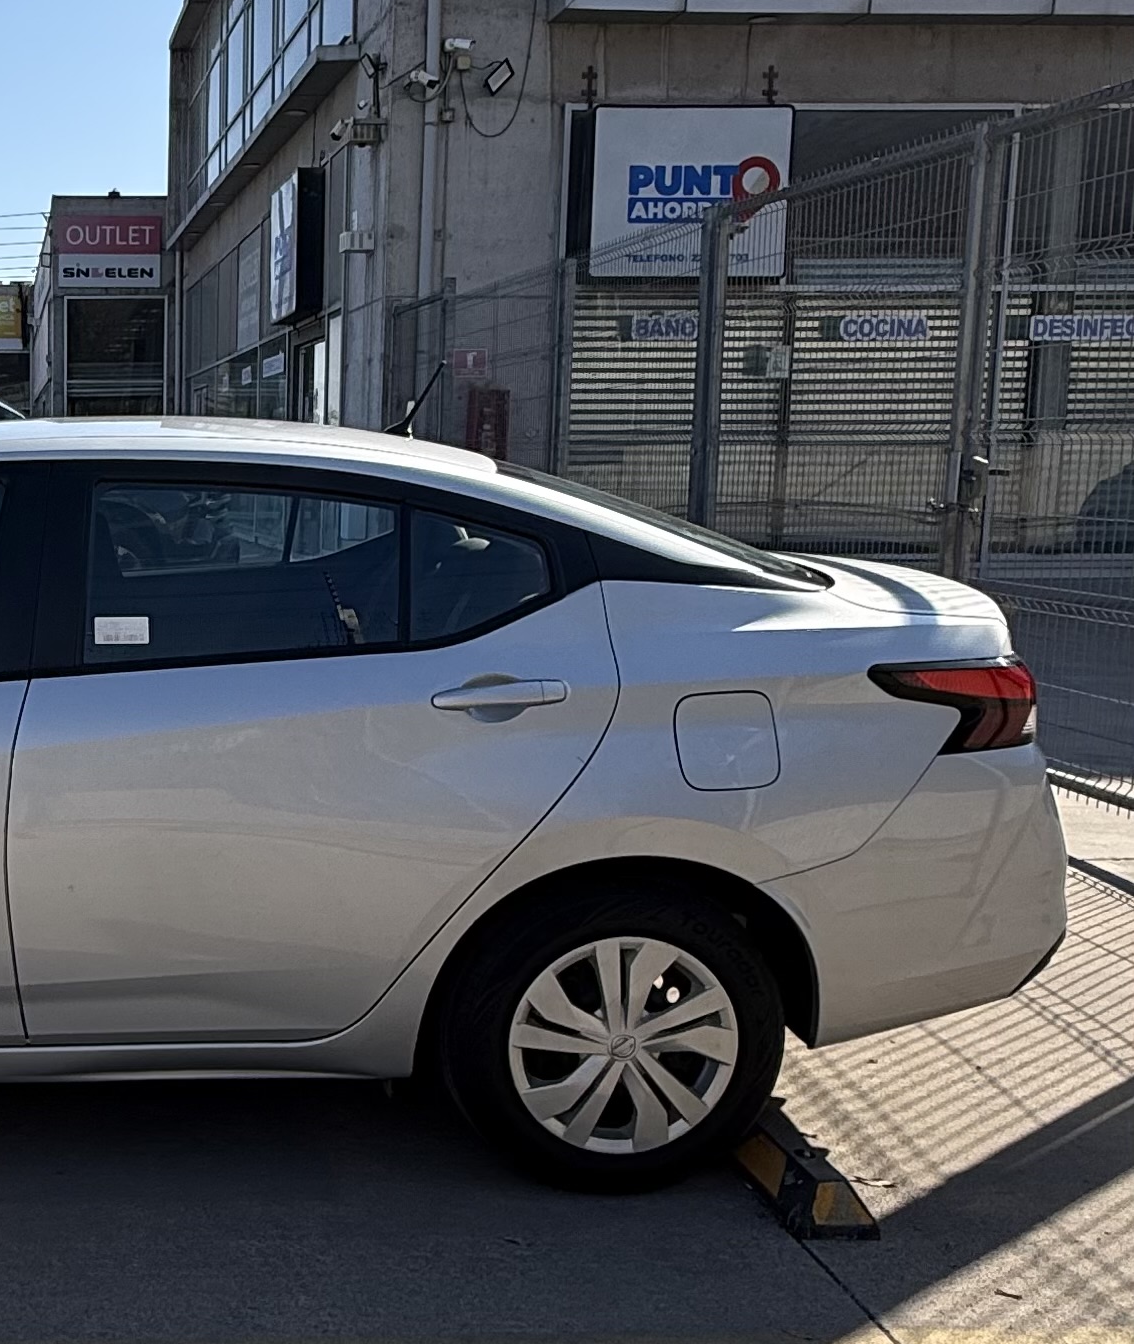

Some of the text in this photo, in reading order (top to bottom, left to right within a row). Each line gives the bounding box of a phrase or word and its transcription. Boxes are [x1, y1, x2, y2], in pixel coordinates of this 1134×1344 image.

[628, 156, 780, 198] PUNTO
[66, 225, 155, 246] OUTLET
[843, 318, 927, 338] COCINA
